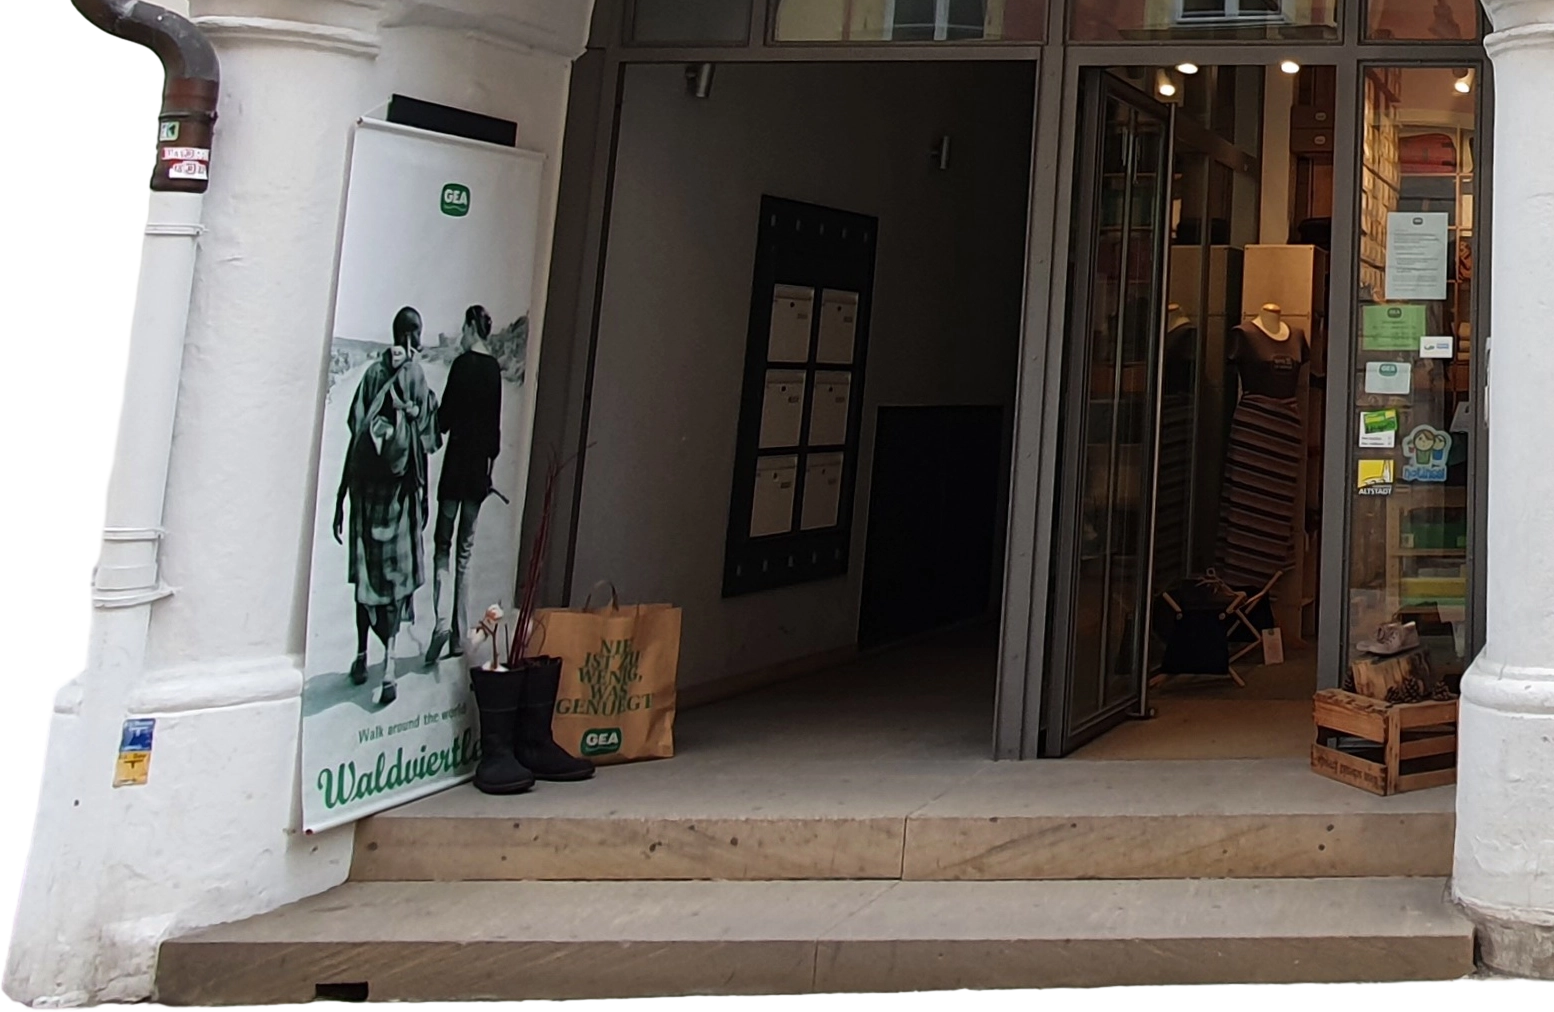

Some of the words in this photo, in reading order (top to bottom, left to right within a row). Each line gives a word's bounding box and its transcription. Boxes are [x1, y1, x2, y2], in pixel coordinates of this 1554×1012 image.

[444, 188, 468, 205] GEA
[591, 684, 628, 702] WAS
[358, 724, 384, 744] Walk
[387, 714, 420, 735] around
[423, 710, 440, 726] the
[441, 702, 468, 721] world
[585, 732, 619, 746] GEA
[317, 727, 482, 809] Waldviertle
